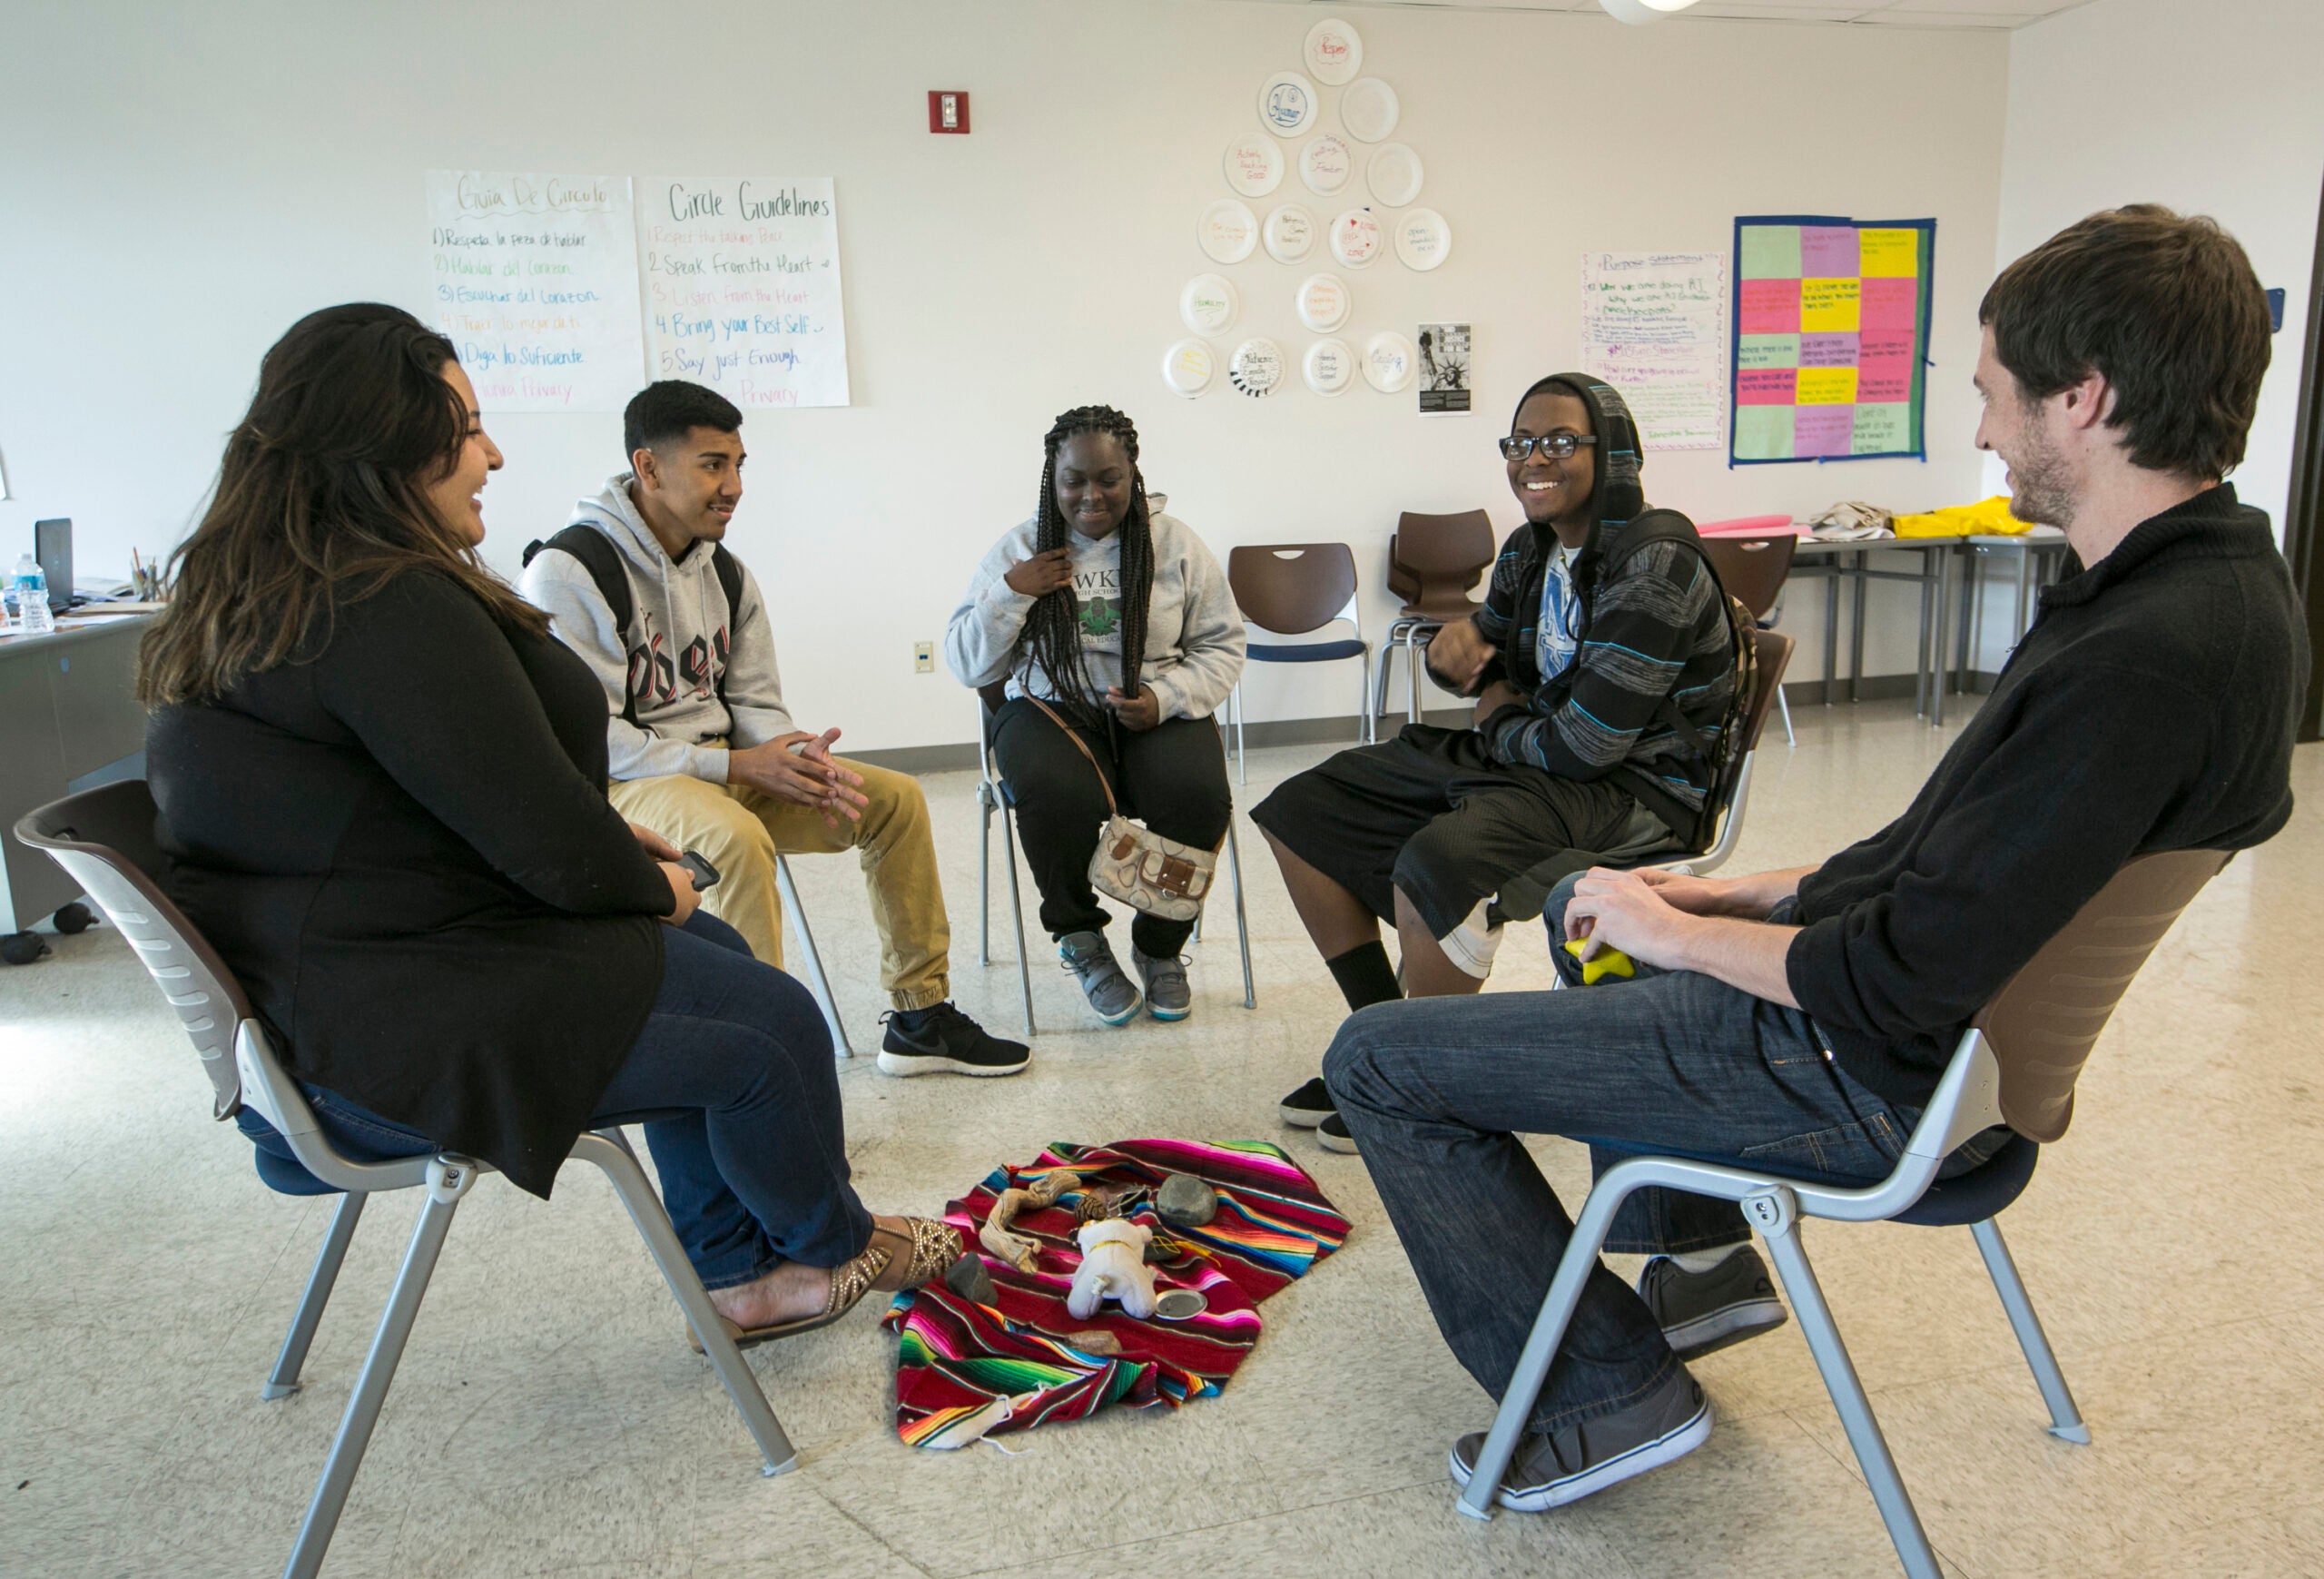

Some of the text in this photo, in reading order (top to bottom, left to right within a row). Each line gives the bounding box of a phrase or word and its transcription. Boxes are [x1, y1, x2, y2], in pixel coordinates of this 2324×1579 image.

[457, 175, 507, 210] Guia
[547, 178, 607, 208] Circulo
[670, 181, 831, 222] Circle Guidelines
[664, 254, 706, 277] Speak
[776, 253, 814, 273] Heart
[671, 312, 716, 343] Bring
[753, 314, 783, 334] Best
[783, 313, 810, 335] Self
[465, 341, 499, 371] Diga
[519, 345, 584, 366] Suficiente
[675, 347, 705, 376] Say
[748, 347, 802, 372] Enough
[740, 379, 799, 408] Privacy
